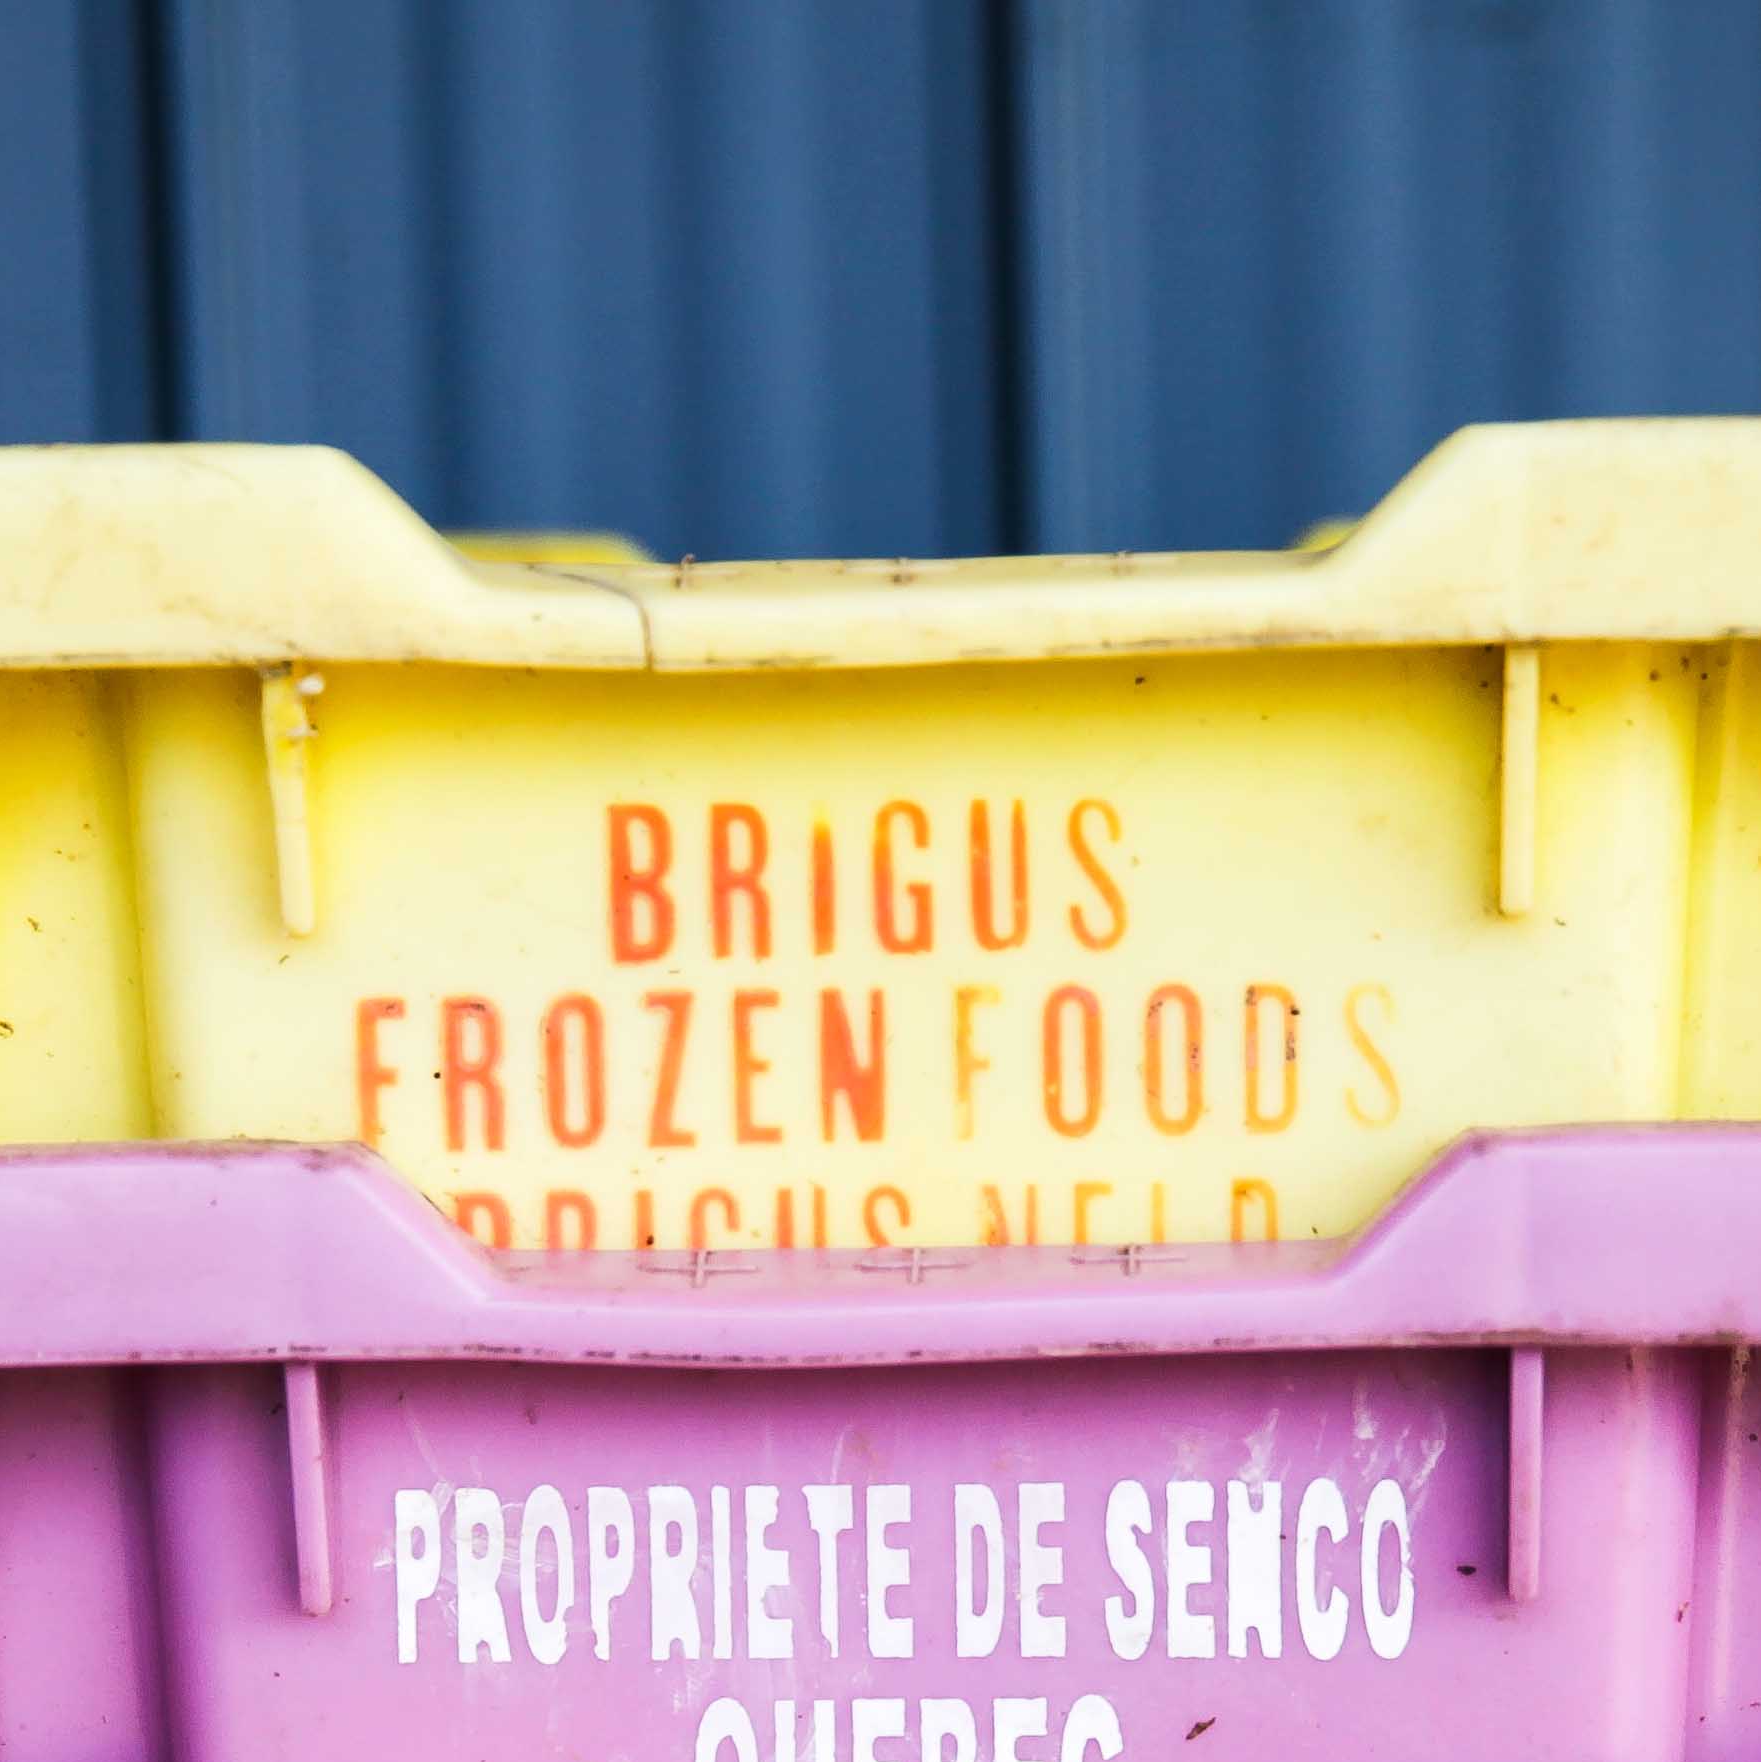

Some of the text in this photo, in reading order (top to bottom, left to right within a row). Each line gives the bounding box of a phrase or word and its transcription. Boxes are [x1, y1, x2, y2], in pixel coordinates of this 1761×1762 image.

[605, 796, 1128, 966] BRIGUS
[355, 980, 1402, 1152] FROZEN FOODS
[394, 1478, 1416, 1665] PROPRIETE DE SENCO
